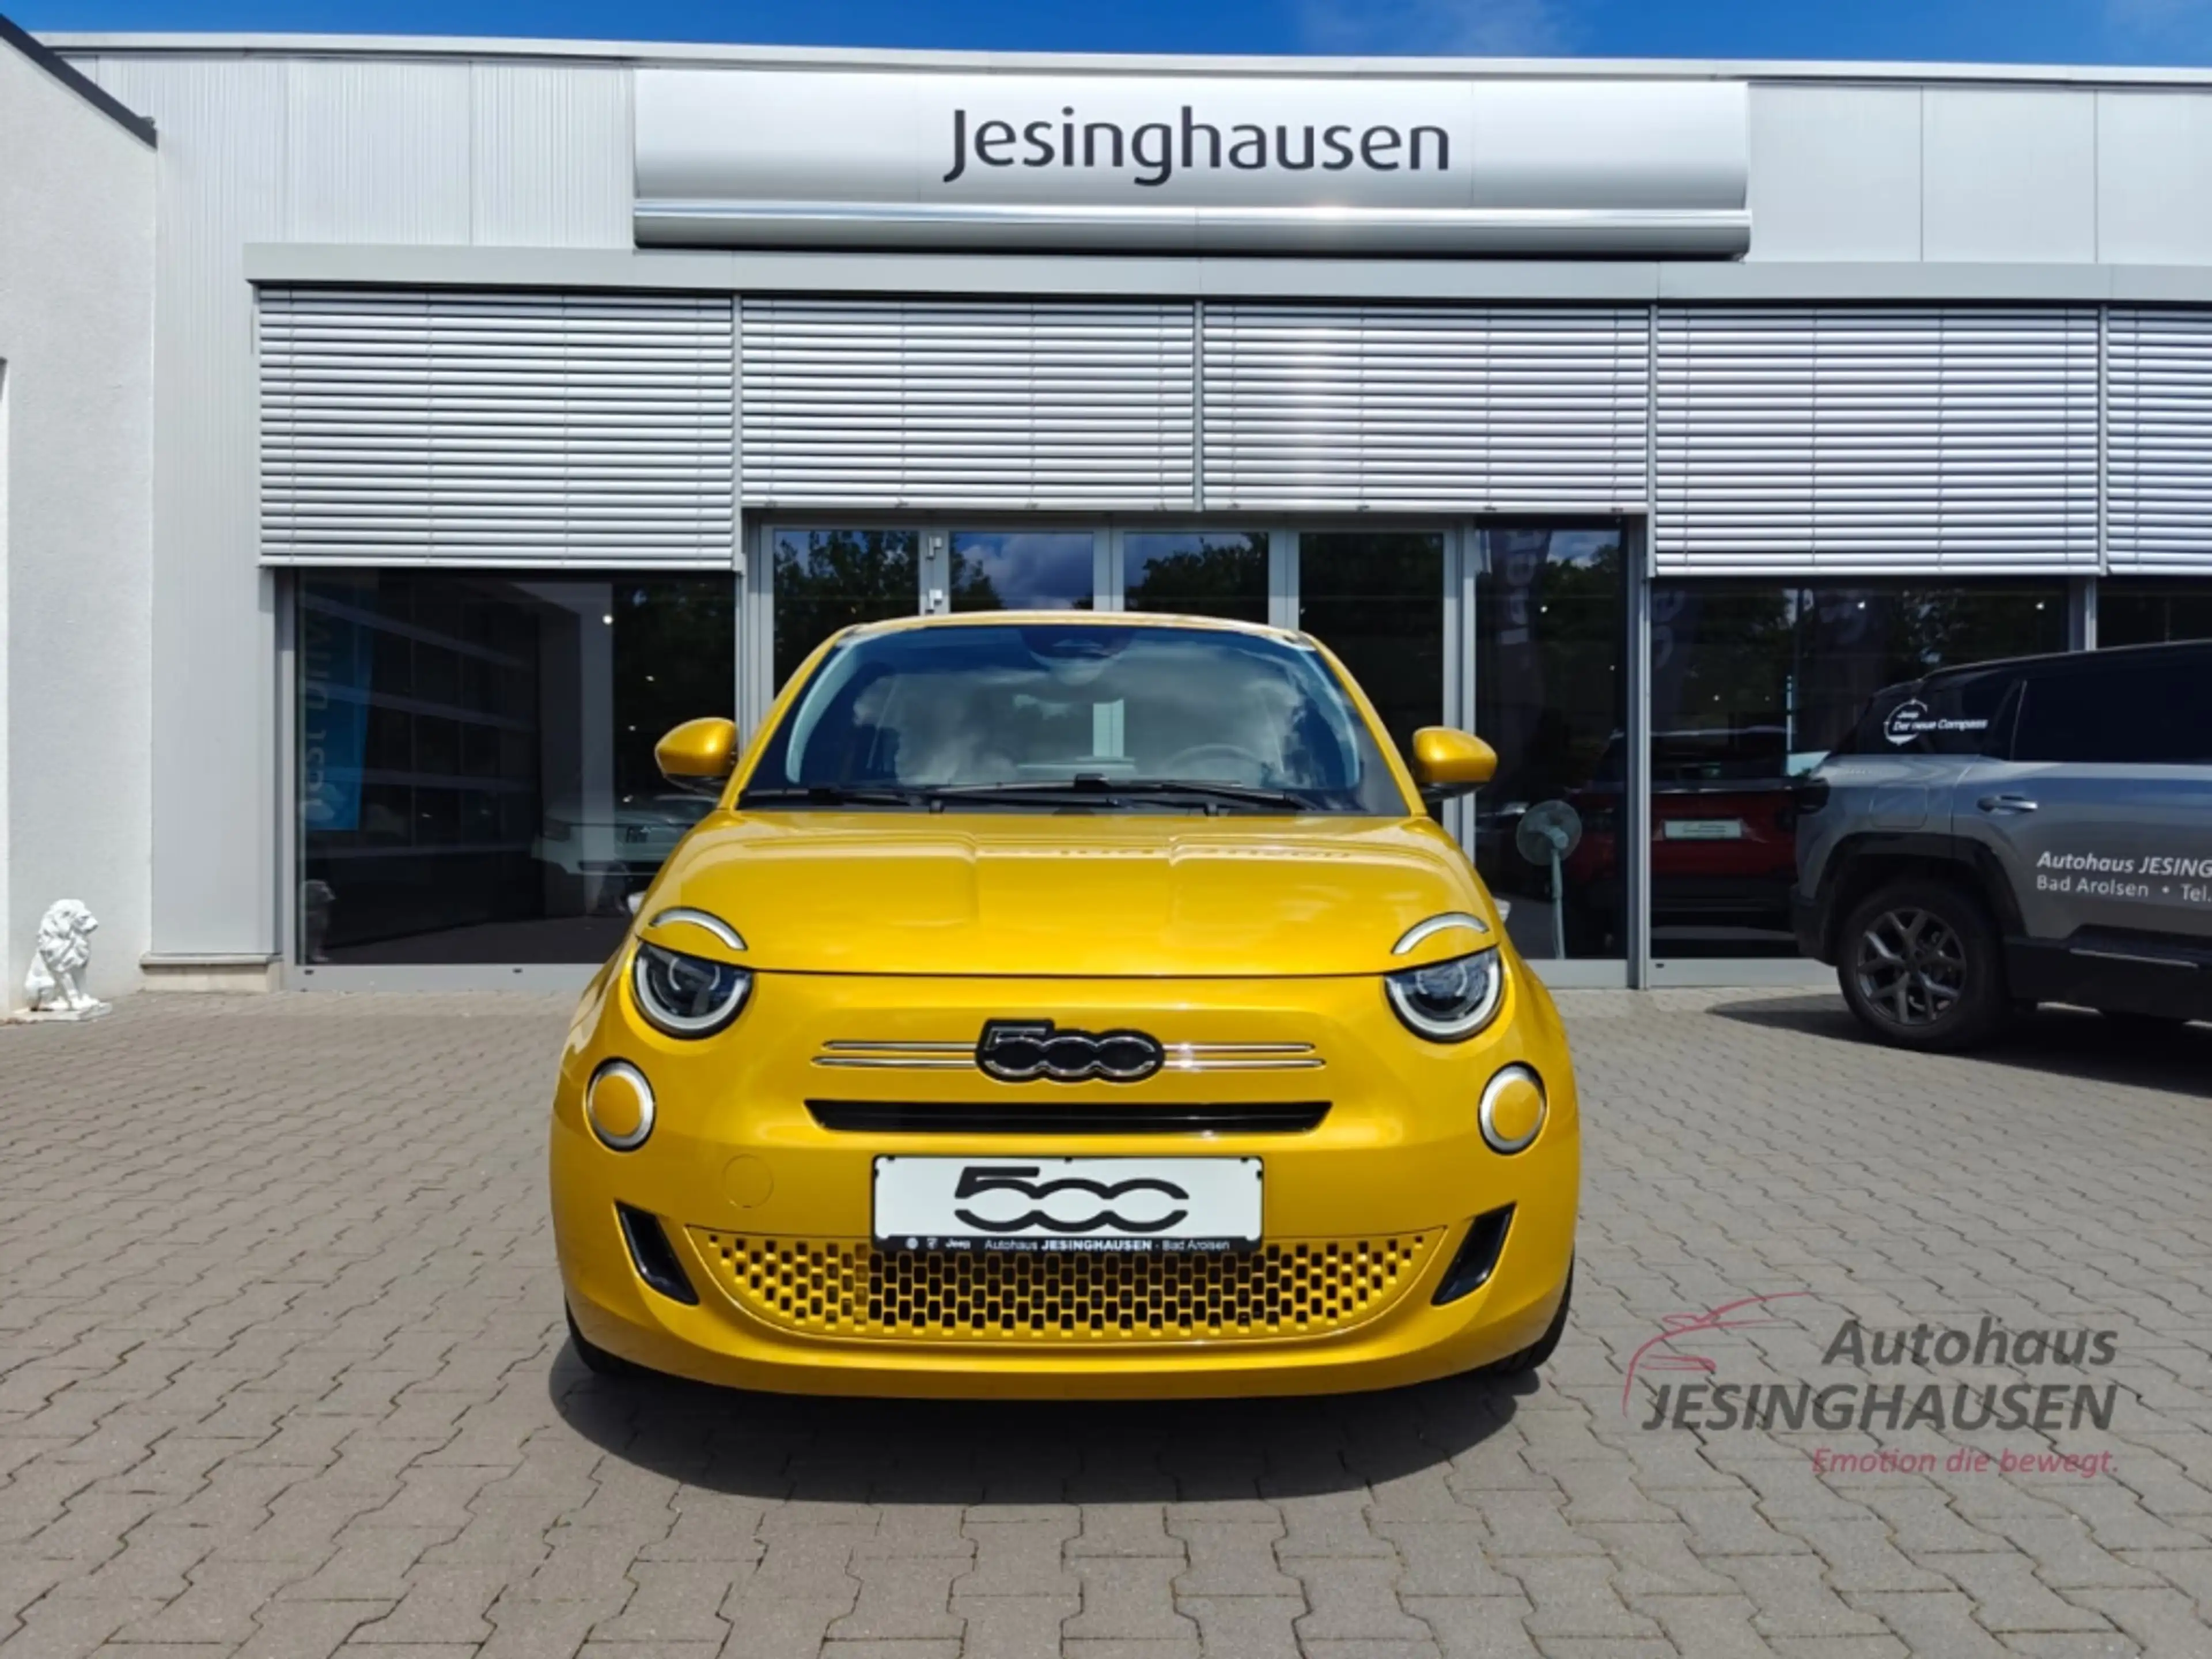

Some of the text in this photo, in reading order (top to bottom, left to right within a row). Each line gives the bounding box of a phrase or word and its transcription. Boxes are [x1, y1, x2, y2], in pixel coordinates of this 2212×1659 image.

[942, 105, 1449, 187] Jesinghausen
[1893, 718, 1988, 732] Der neue Compass
[2036, 851, 2212, 878] Autohaus JESING
[2036, 874, 2212, 902] Bad Arolsen Tel.
[983, 1025, 1157, 1077] 500
[954, 1166, 1190, 1233] 500
[984, 1239, 1037, 1250] Autohaus
[1041, 1239, 1152, 1251] JESINGHAUSEN
[1162, 1239, 1184, 1251] Bad
